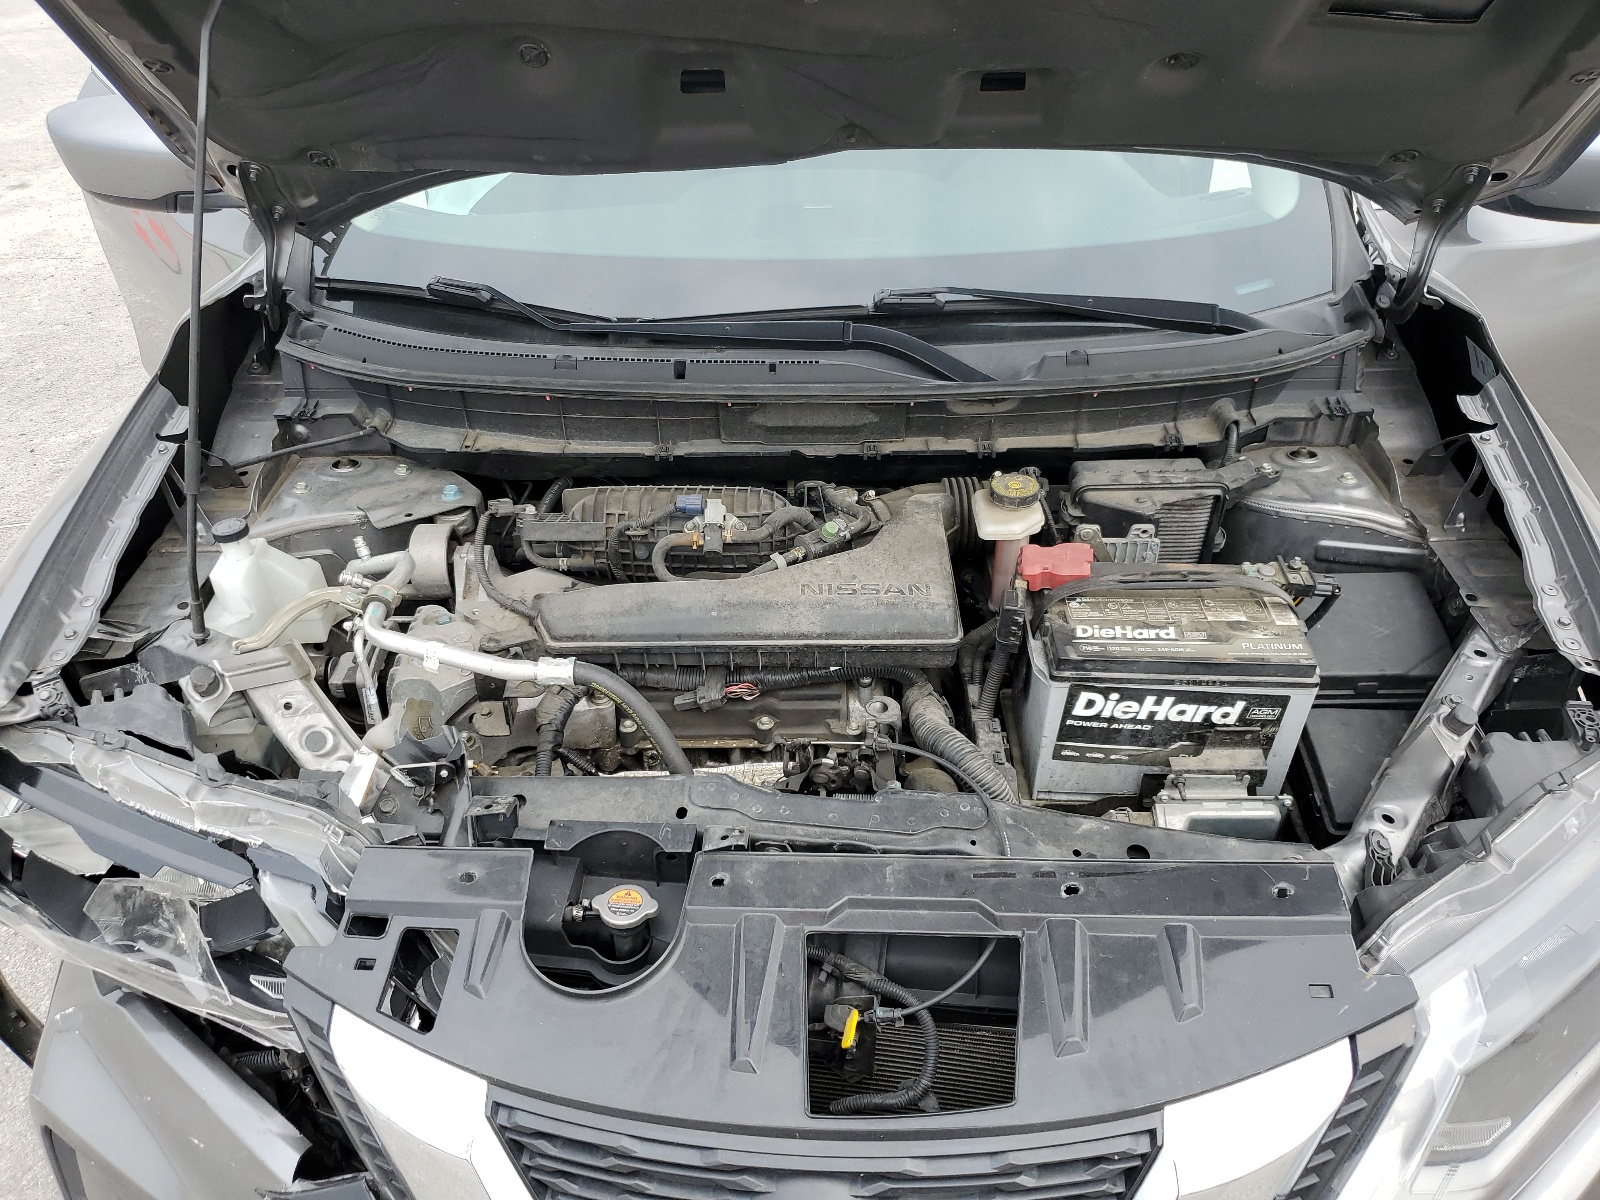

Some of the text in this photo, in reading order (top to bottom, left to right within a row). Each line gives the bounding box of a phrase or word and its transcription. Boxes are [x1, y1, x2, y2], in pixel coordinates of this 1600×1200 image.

[800, 583, 932, 596] NISSAN
[1076, 624, 1176, 639] DieHard
[1242, 642, 1303, 650] PLATINUM
[1071, 691, 1247, 725] DieHard
[1066, 719, 1153, 731] POWER AHEAD
